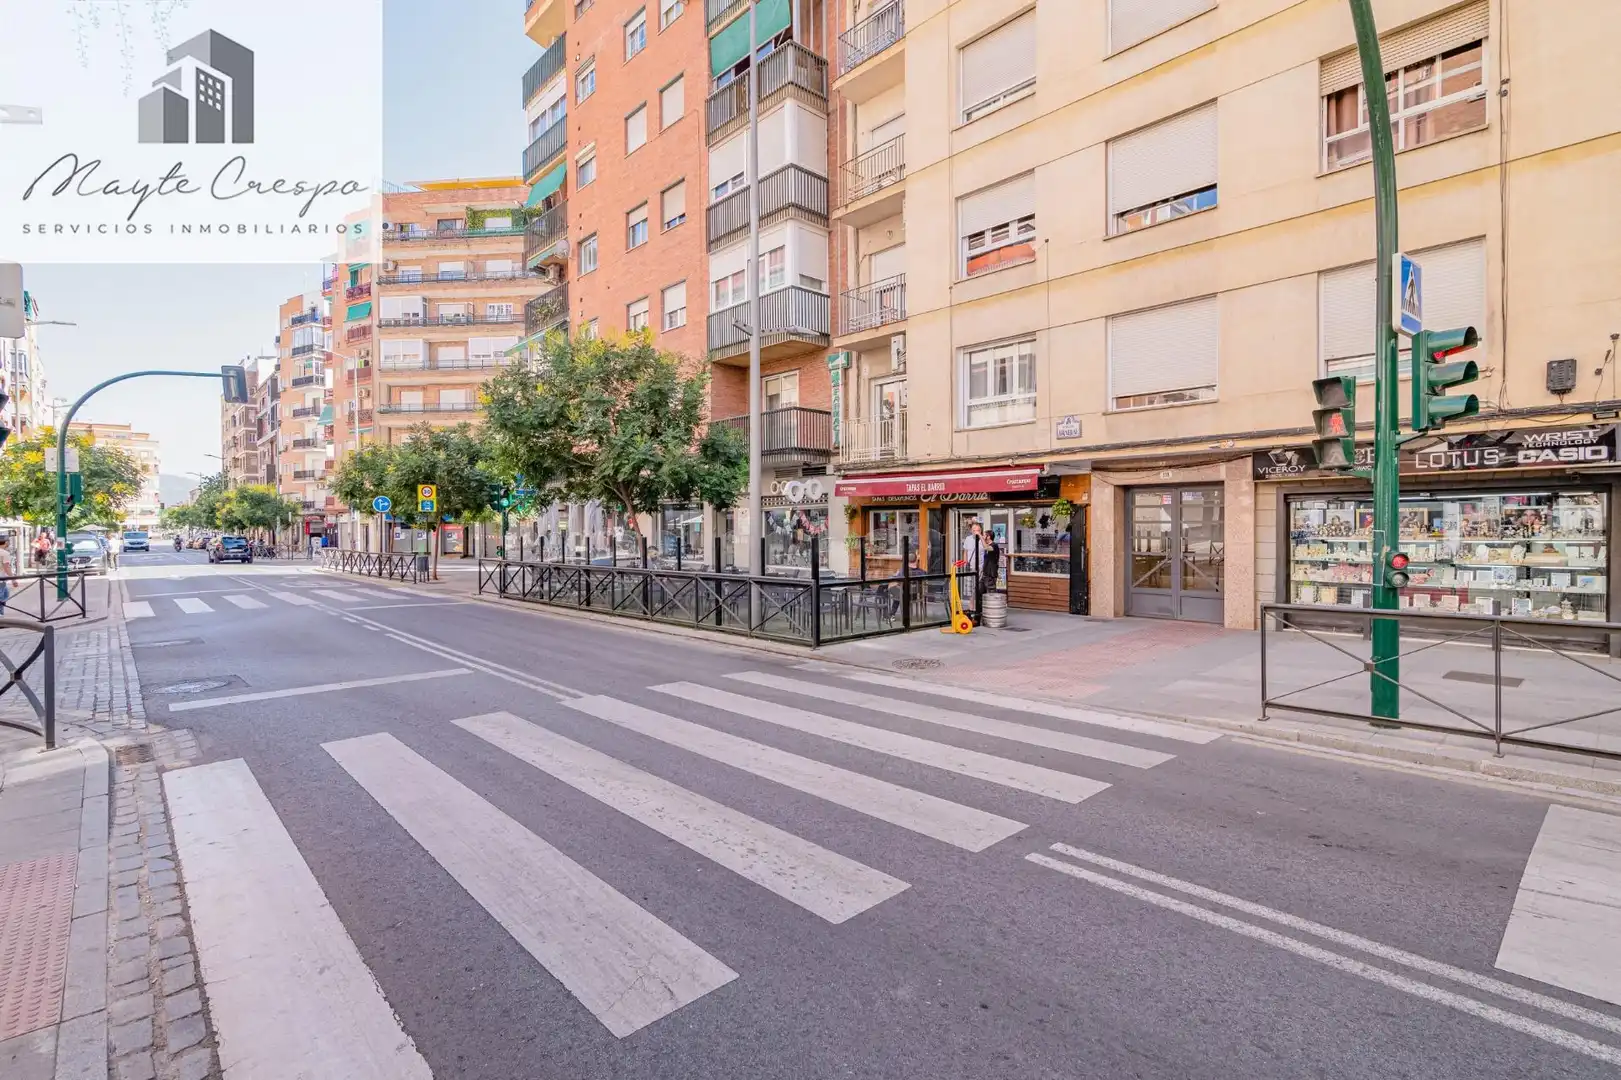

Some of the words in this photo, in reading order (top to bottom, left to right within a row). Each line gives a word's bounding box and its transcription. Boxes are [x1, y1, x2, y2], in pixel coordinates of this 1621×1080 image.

[1522, 436, 1598, 448] TECHNOLOGY
[1524, 429, 1600, 443] WRIST
[1415, 449, 1500, 469] LOTUS
[1517, 446, 1608, 464] CASIO
[1257, 465, 1306, 474] VICEROY
[906, 483, 920, 492] TAPAS
[921, 482, 927, 491] EL
[927, 482, 946, 491] BARRIO
